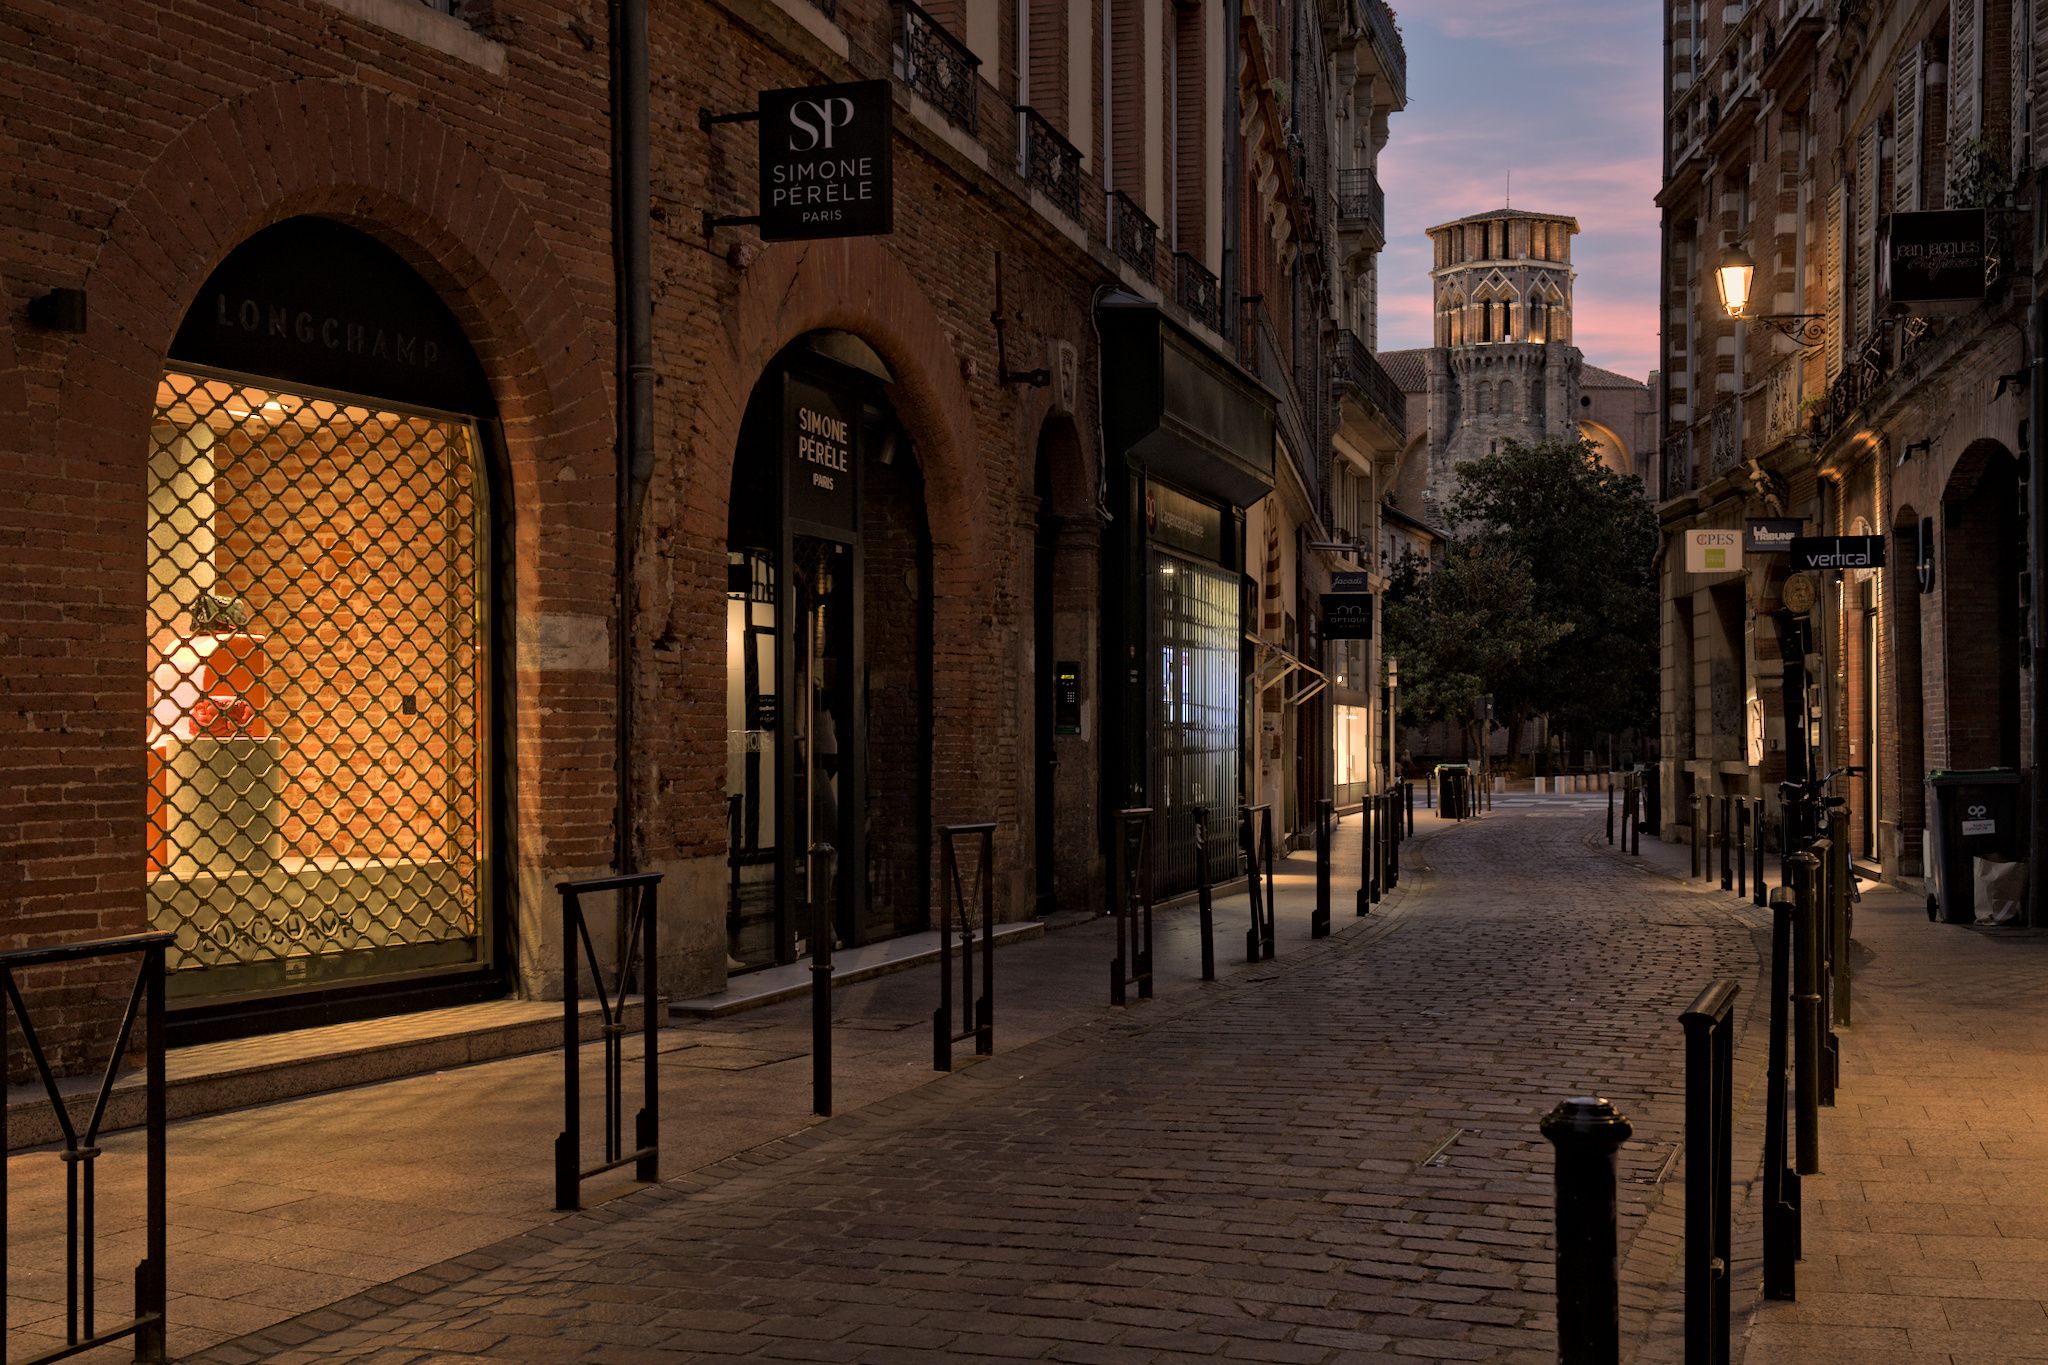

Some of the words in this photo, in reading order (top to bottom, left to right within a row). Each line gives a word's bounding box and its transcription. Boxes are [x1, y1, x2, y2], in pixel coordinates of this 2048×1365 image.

[773, 157, 873, 183] SIMONE
[773, 180, 873, 207] PÉRÈLE
[802, 209, 843, 223] PARIS
[1893, 243, 1924, 261] jean
[1926, 240, 1980, 258] jacques
[216, 293, 439, 369] LONGCHAMP
[799, 407, 848, 446] SIMONE
[799, 434, 848, 473] PÉRÈLE
[812, 472, 834, 491] PARIS
[1806, 538, 1871, 567] vertical
